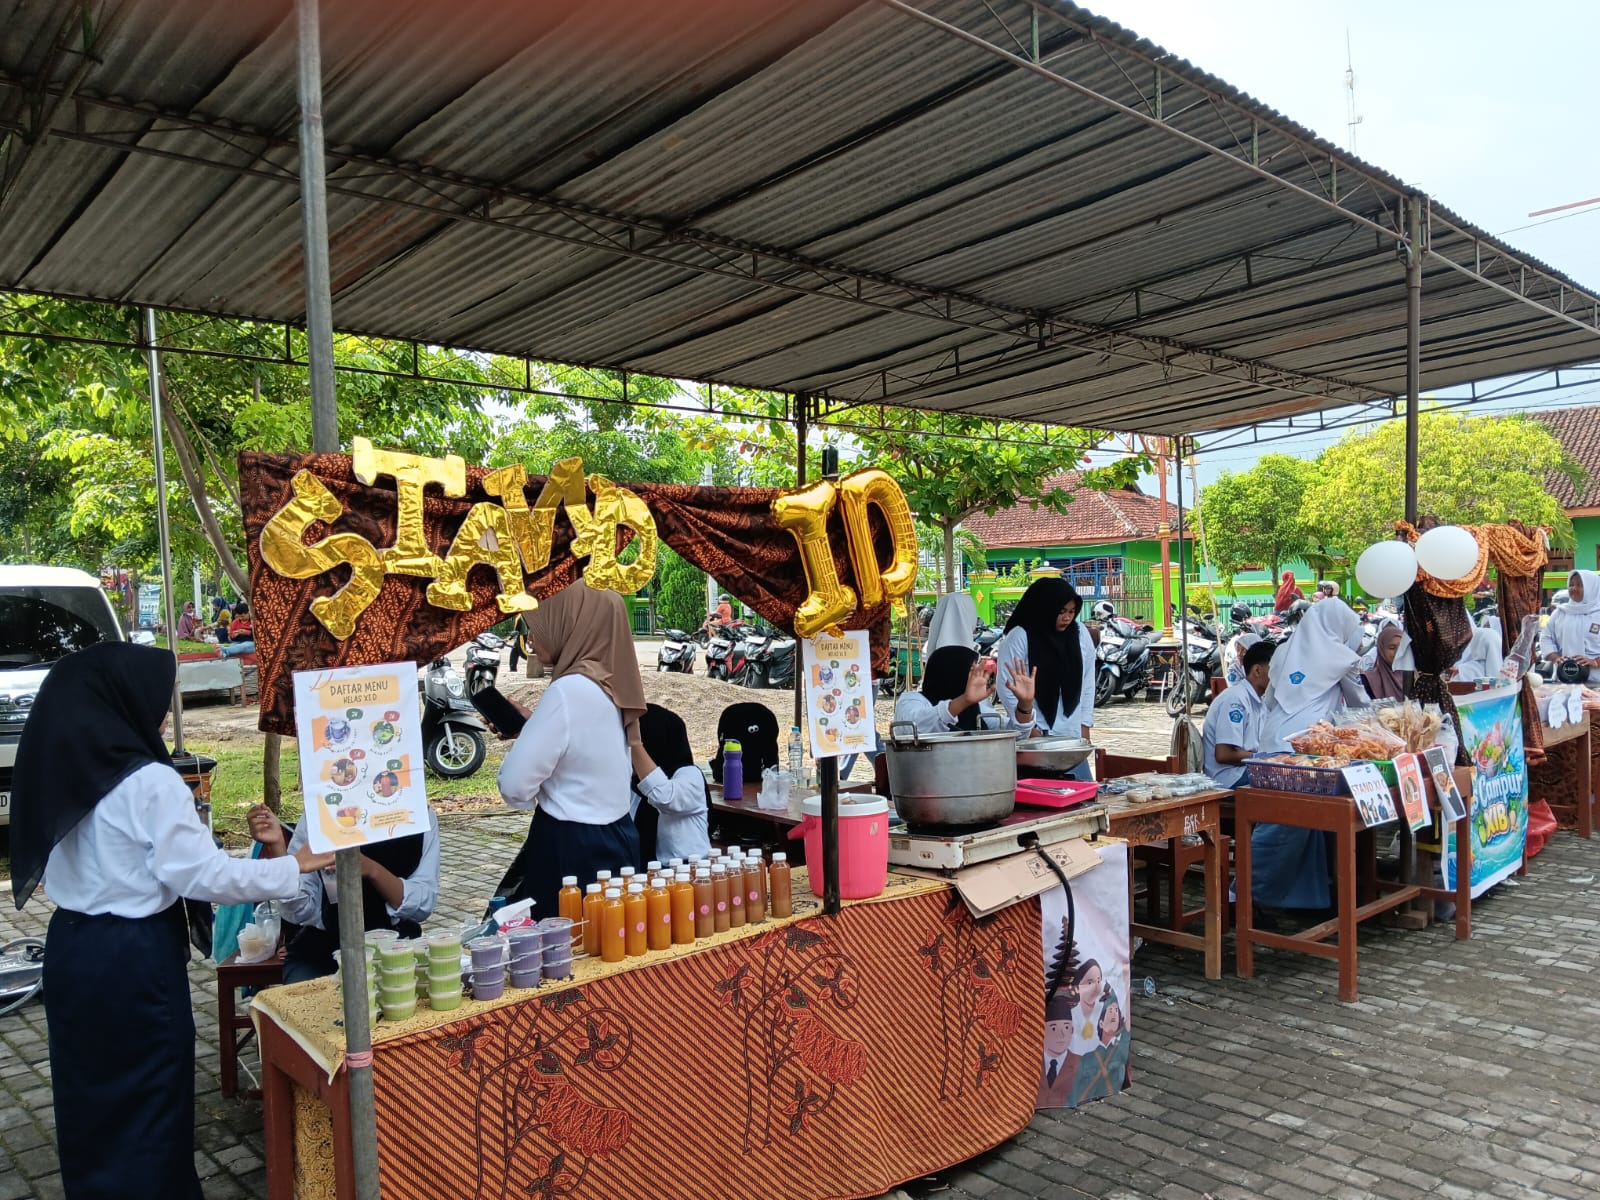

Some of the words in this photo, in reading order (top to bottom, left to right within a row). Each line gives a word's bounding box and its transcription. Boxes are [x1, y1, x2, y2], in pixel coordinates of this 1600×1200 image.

[259, 435, 658, 640] STAND
[821, 642, 839, 651] DAFTAR
[330, 683, 362, 696] DAFTAR
[364, 680, 388, 692] MENU
[343, 695, 362, 704] KELAS
[1479, 773, 1523, 808] Campur
